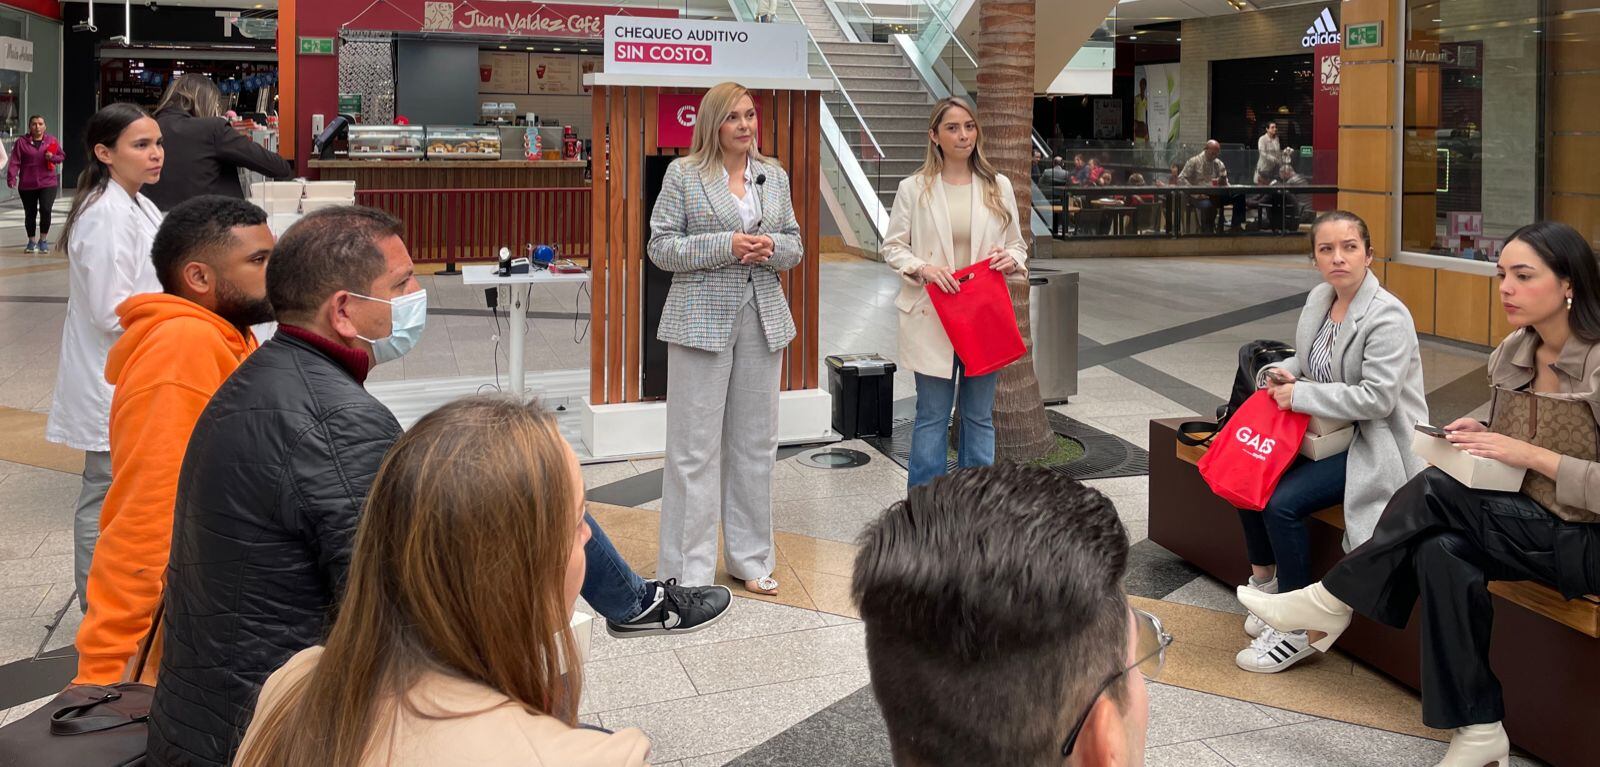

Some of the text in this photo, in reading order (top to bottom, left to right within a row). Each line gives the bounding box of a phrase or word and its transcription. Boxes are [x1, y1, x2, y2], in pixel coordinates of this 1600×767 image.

[458, 9, 601, 33] Juan Valdez Café
[614, 26, 748, 43] CHEQUEO AUDITIVO
[617, 44, 709, 62] SIN COSTO.
